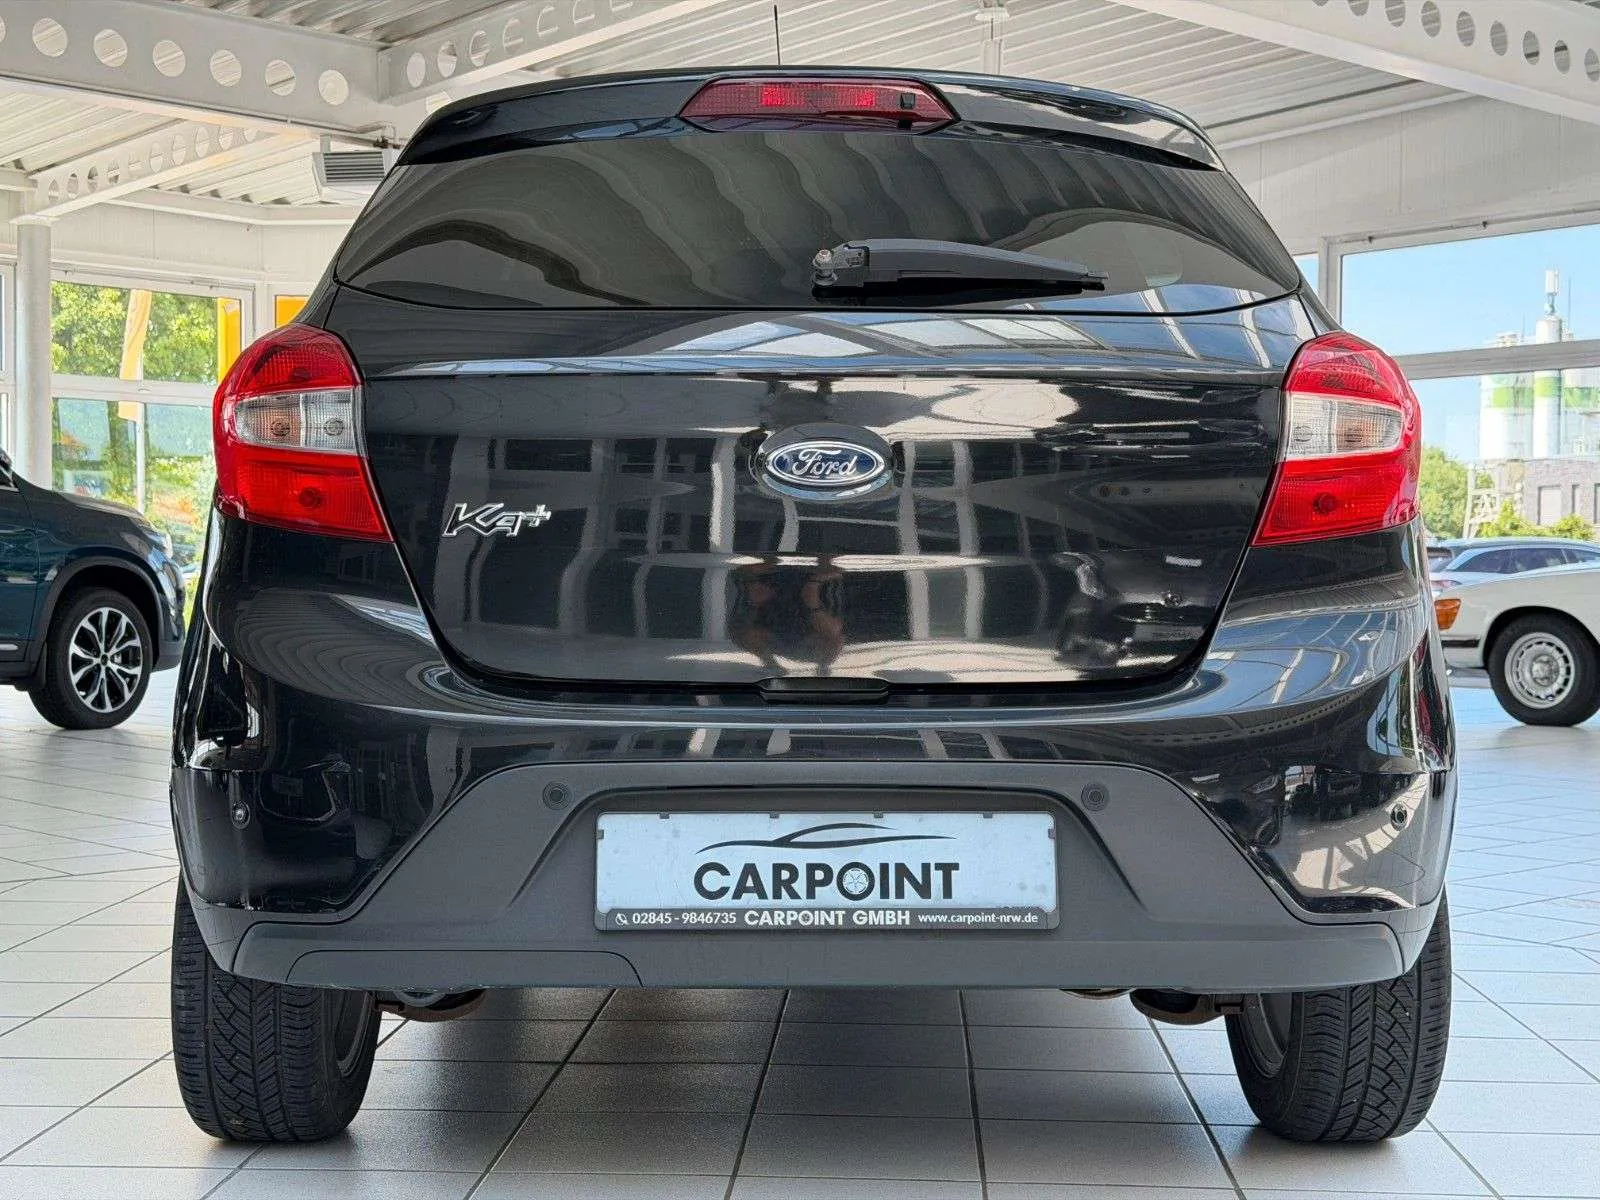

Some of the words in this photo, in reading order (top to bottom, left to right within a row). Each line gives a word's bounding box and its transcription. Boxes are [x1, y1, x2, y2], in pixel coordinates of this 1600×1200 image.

[791, 448, 858, 475] Ford
[693, 861, 960, 901] CARPOINT
[632, 912, 672, 925] 02845
[681, 912, 737, 925] 9846735
[744, 910, 846, 926] CARPOINT
[852, 910, 910, 926] GMBH
[917, 911, 1039, 925] www.carpoint-nrw.de
